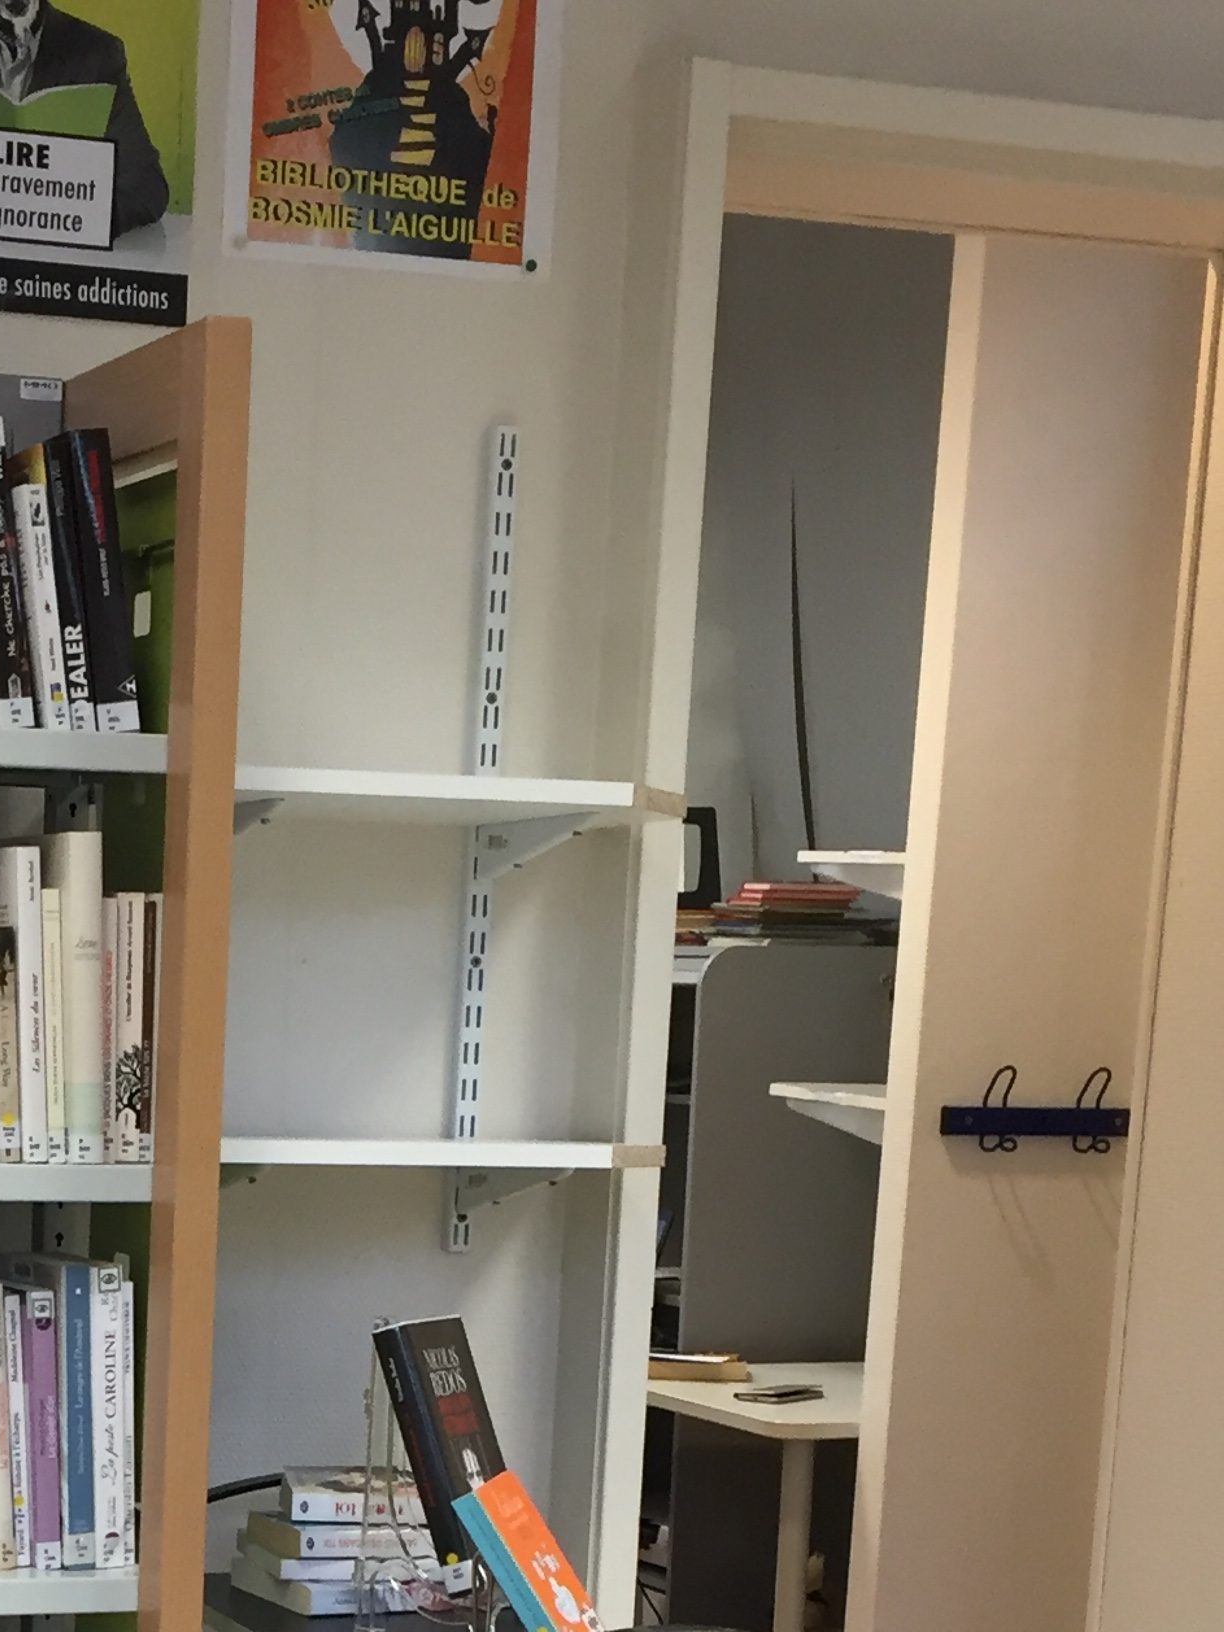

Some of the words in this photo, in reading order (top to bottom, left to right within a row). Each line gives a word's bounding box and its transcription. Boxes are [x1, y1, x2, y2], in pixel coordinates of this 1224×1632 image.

[256, 158, 468, 206] BIBLIOTHEQUE
[482, 185, 518, 212] de
[249, 197, 362, 232] BOSMIE
[368, 208, 522, 248] L'AIGUILLE
[13, 273, 72, 301] saines
[77, 278, 170, 310] addictions
[0, 581, 16, 635] cherche
[7, 640, 17, 657] Ne
[65, 624, 90, 699] EALER
[104, 1330, 117, 1419] CAROLINE
[423, 1346, 462, 1366] NICOLAS
[429, 1367, 467, 1397] BEDOS
[100, 1459, 117, 1485] La
